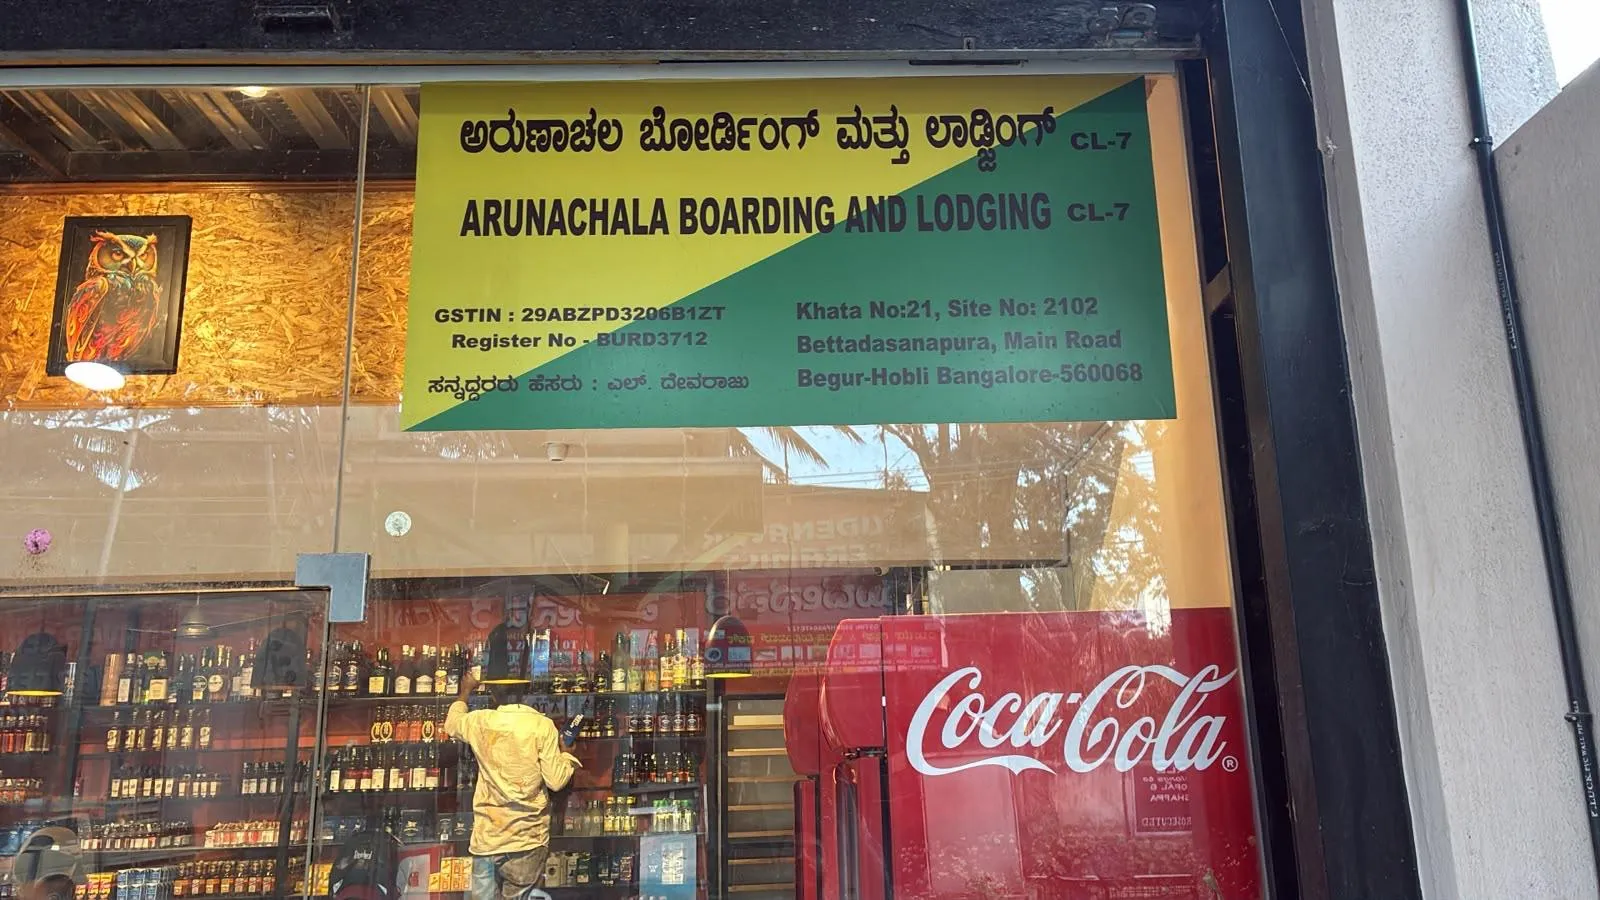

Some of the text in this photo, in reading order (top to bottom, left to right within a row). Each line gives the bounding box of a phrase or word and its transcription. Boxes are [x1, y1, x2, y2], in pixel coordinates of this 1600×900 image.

[460, 104, 1057, 172] ಅರುಣಾಚಲ ಬೋರ್ಡಿಂಗ್ ಮತ್ತು ಲಾಡ್ಜಿಂಗ್
[1070, 132, 1133, 150] CL-7
[459, 192, 1052, 237] ARUNACHALA BOARDING AND LODGING
[1067, 203, 1131, 222] CL-7
[434, 308, 502, 323] GSTIN
[520, 306, 726, 323] 29ABZPD3206B1ZT
[796, 297, 1099, 322] Khata No:21, Site No: 2102
[451, 333, 541, 352] Register
[548, 333, 577, 348] No
[597, 332, 709, 347] BURD3712
[797, 330, 1122, 355] Bettadasanapura, Main Road
[528, 373, 584, 392] ಹೆಸರು
[660, 371, 750, 390] ದೇವರಾಜು
[797, 363, 1144, 391] Begur-Hobli Bangalore-560068
[906, 664, 1238, 776] Coca-Cola
